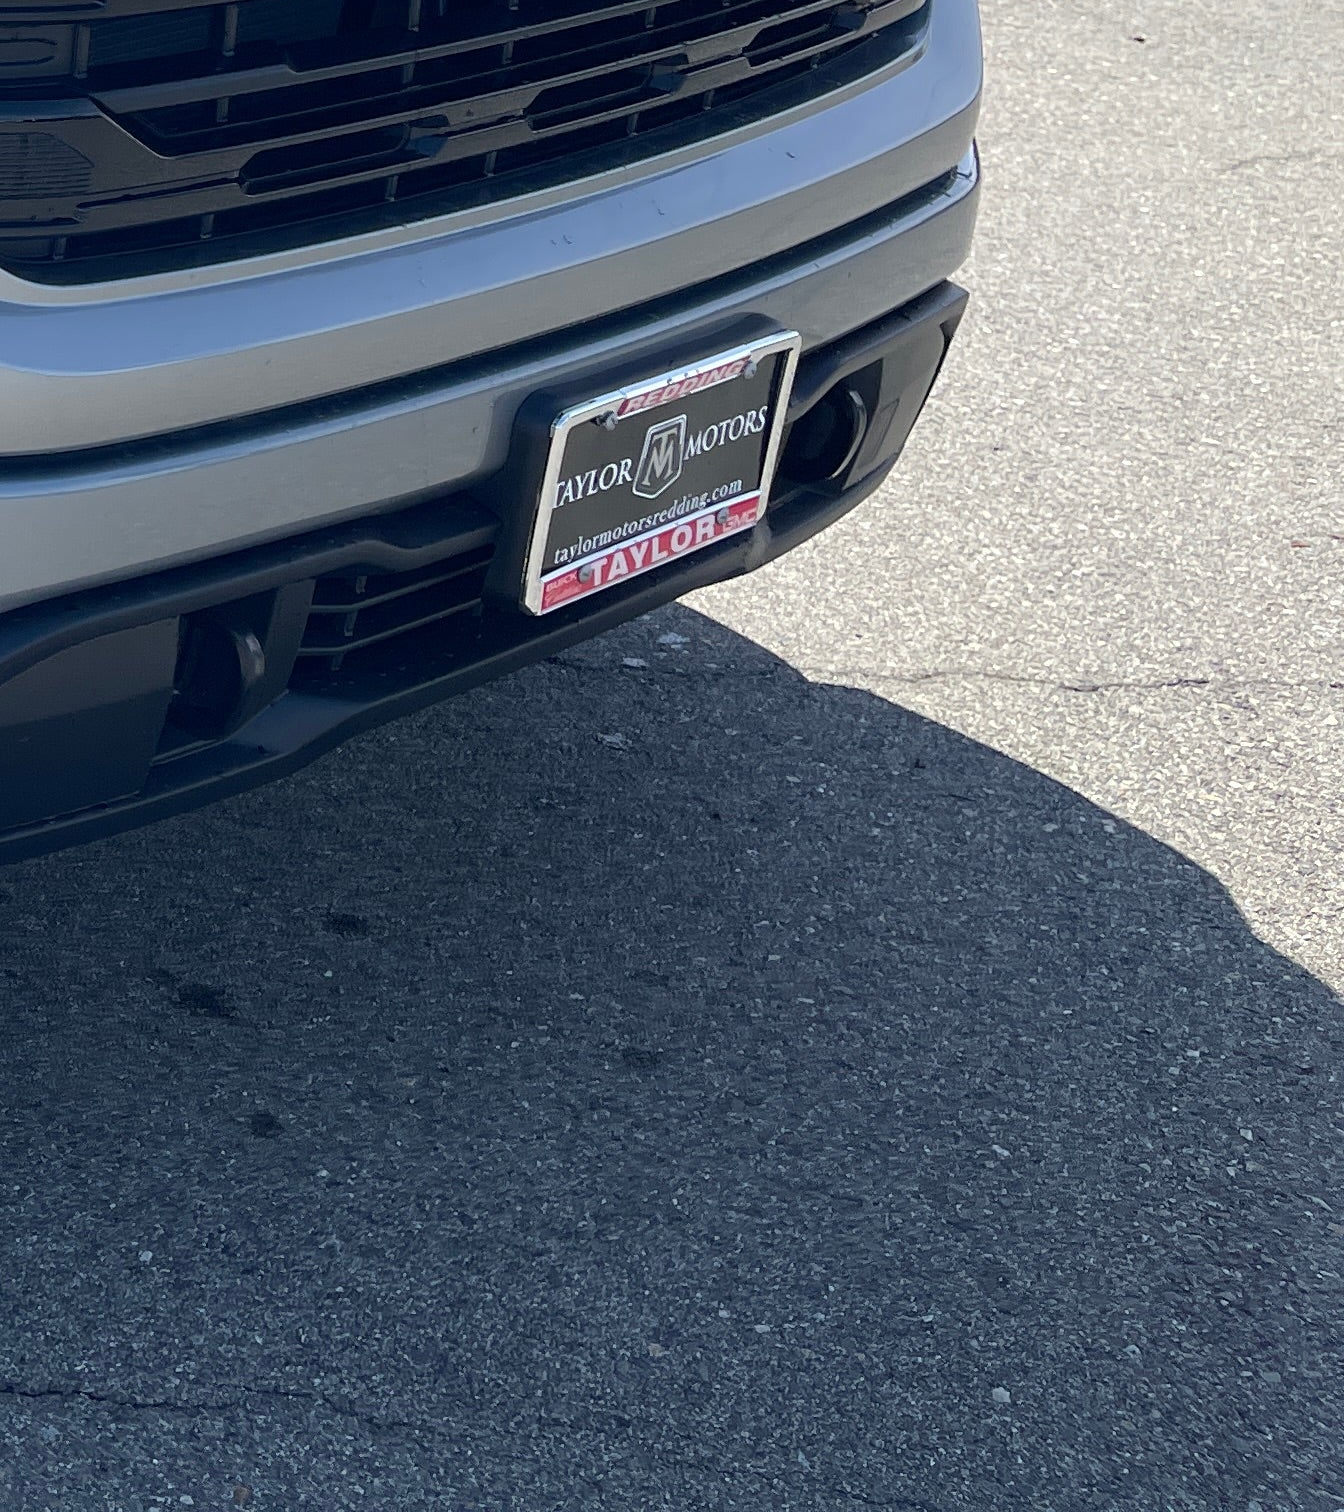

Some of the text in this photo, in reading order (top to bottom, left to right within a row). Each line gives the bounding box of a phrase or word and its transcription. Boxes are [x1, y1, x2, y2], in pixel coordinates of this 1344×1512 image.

[623, 360, 746, 414] REDDING
[552, 405, 769, 509] TAYLOR MOTORS
[553, 478, 743, 566] taylormotorsredding.com
[590, 513, 716, 588] TAYLOR
